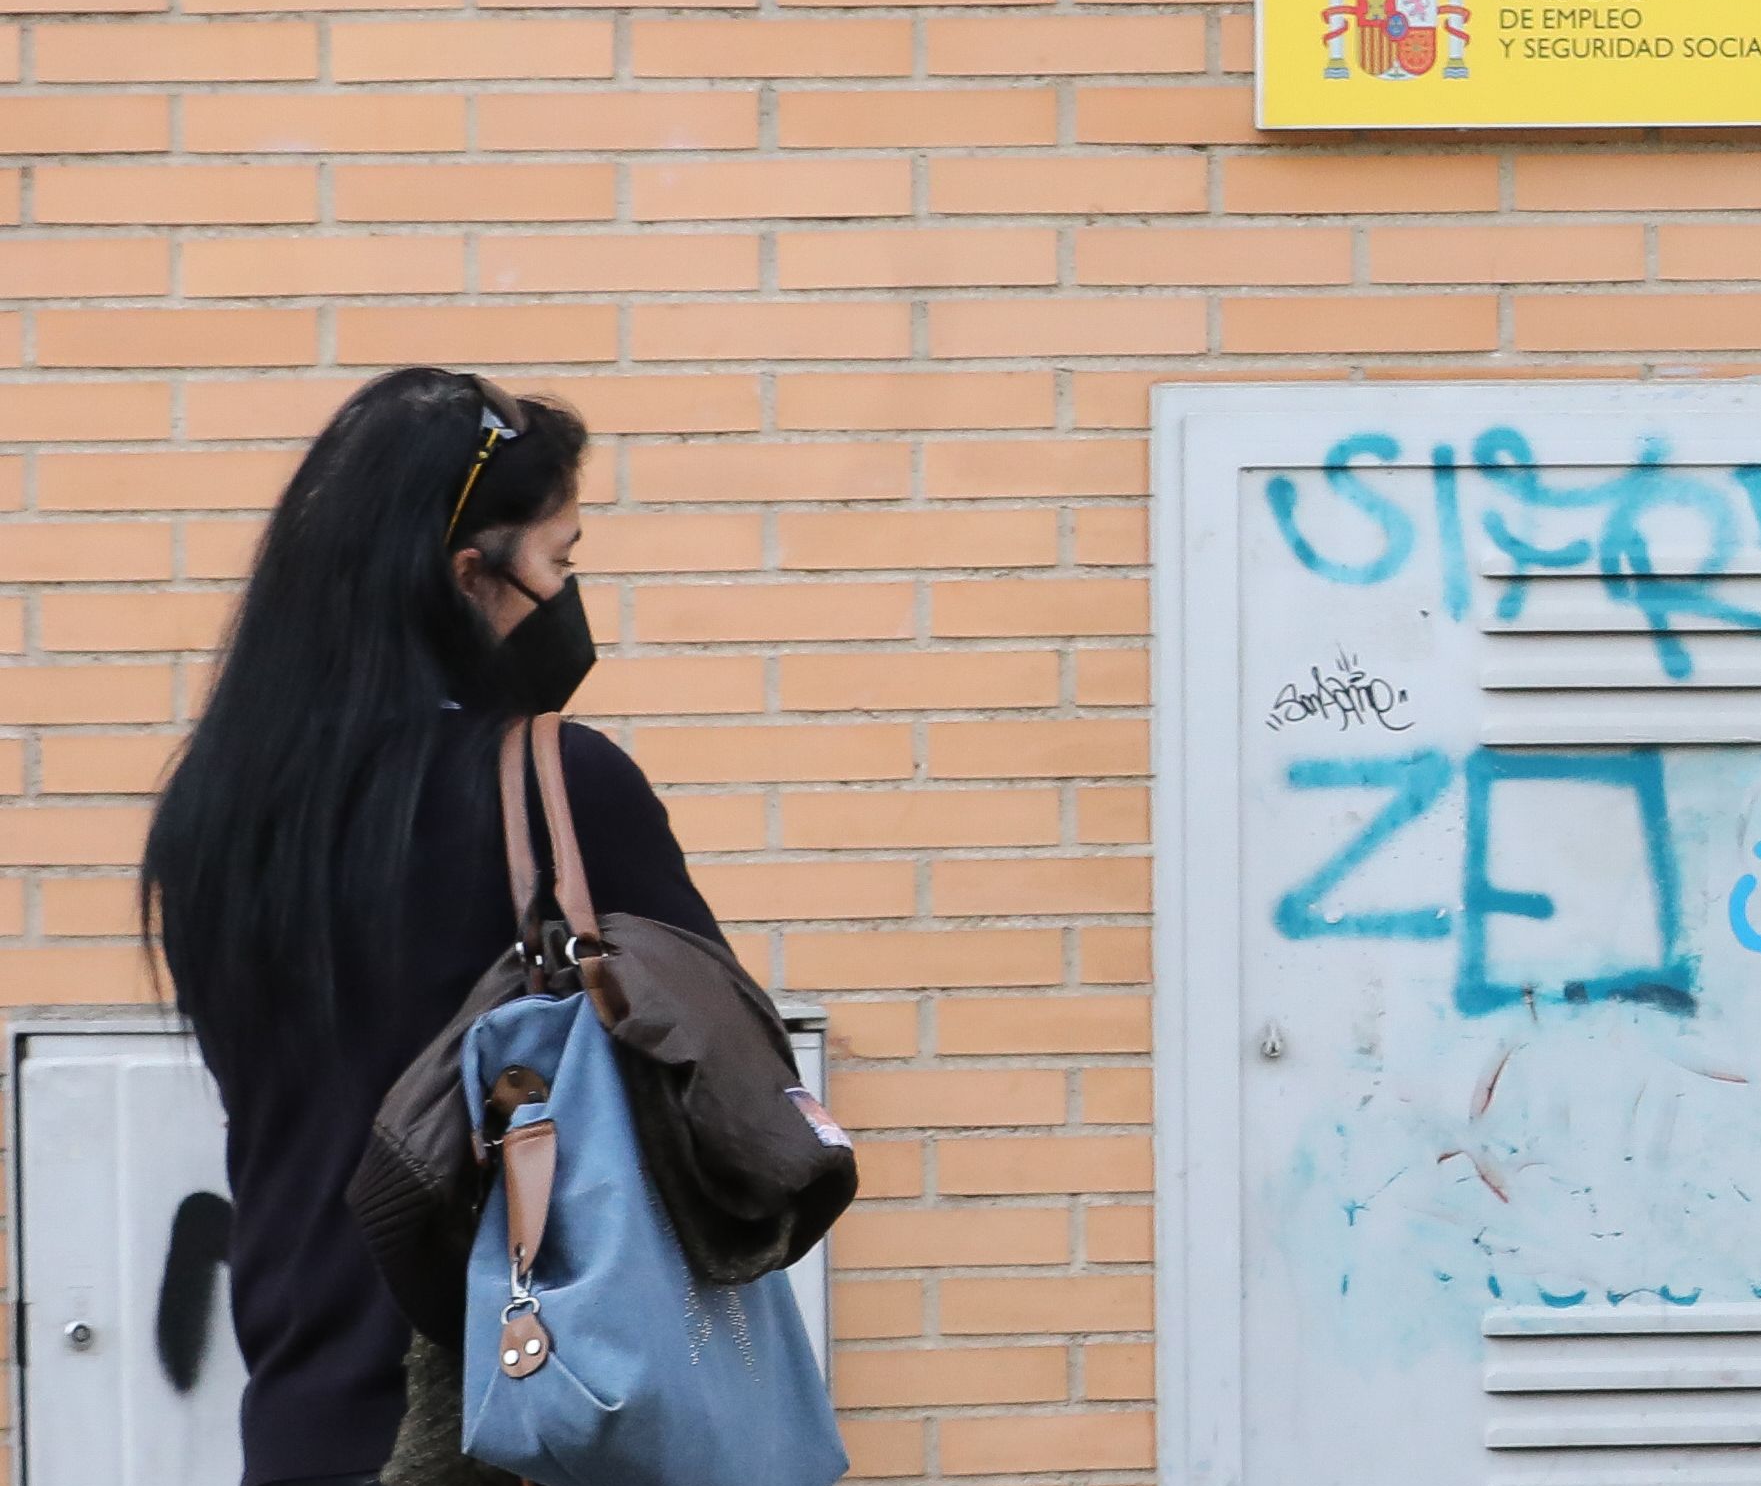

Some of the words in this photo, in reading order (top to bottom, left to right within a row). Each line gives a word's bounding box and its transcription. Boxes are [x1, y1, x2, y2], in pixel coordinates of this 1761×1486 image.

[1500, 8, 1533, 29] DE
[1542, 8, 1643, 29] EMPLEO
[1499, 38, 1515, 58] Y
[1524, 37, 1674, 58] SEGURIDAD
